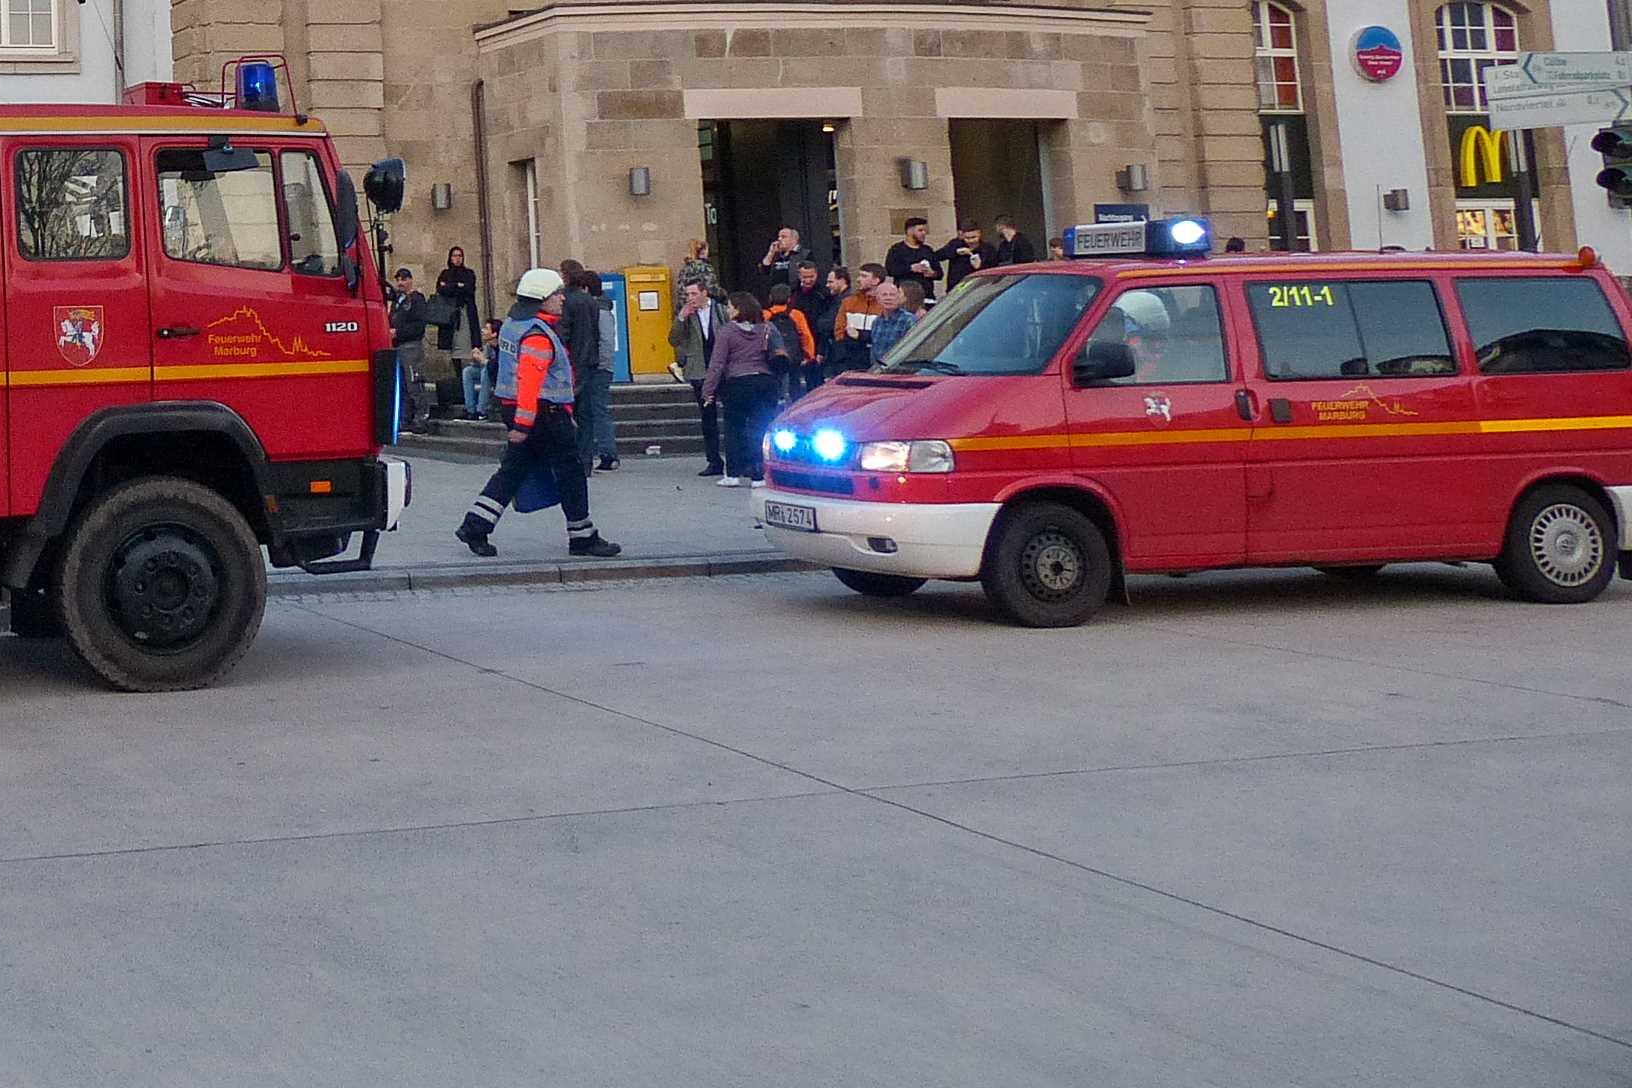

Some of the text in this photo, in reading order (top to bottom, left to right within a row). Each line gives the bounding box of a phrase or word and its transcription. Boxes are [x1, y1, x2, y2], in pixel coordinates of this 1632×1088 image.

[1077, 231, 1142, 249] FEUERWEHR
[1268, 285, 1335, 307] 2/11-1
[325, 322, 358, 332] 1120
[208, 333, 262, 345] Feuerwehr
[214, 345, 257, 358] Marburg
[1311, 400, 1369, 411] FEUERWEHR
[1319, 411, 1366, 421] MARBURG
